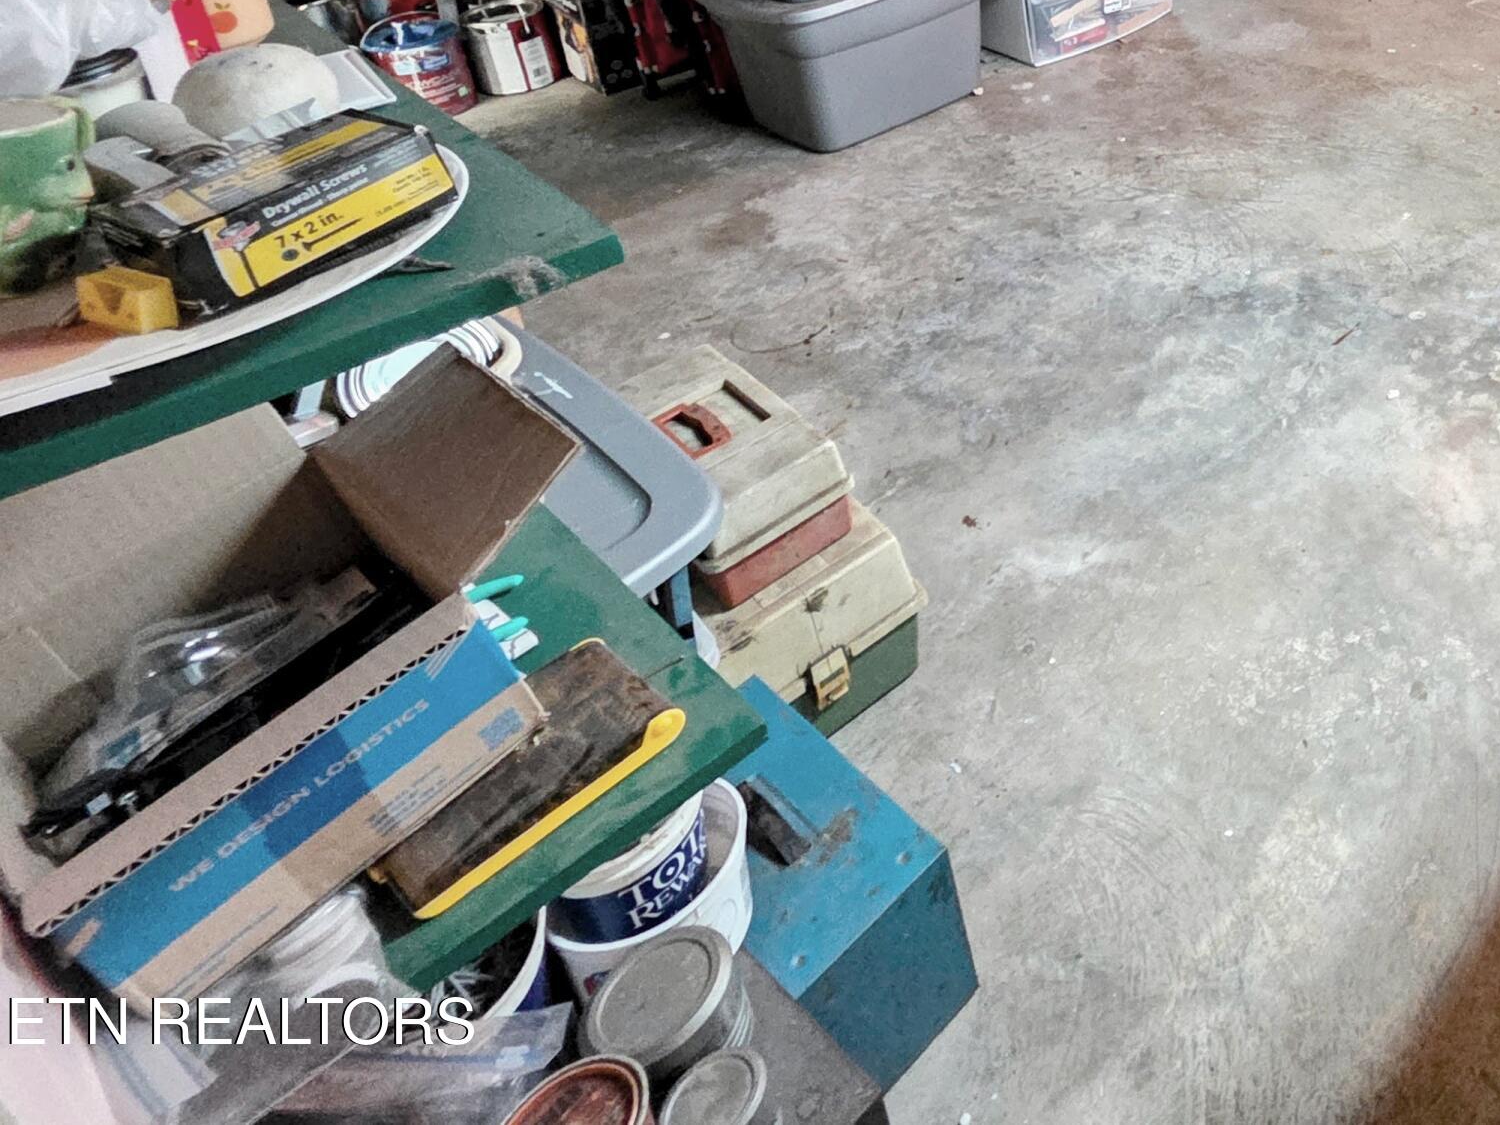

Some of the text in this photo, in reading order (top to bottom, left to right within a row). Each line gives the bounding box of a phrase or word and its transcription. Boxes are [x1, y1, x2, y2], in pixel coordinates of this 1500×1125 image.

[262, 184, 321, 219] Drywall
[320, 164, 368, 191] Screws
[274, 212, 345, 249] 7 x 2 in.
[168, 859, 215, 892] WE
[217, 787, 311, 859] DESIGN
[314, 699, 430, 787] LOGISTICS
